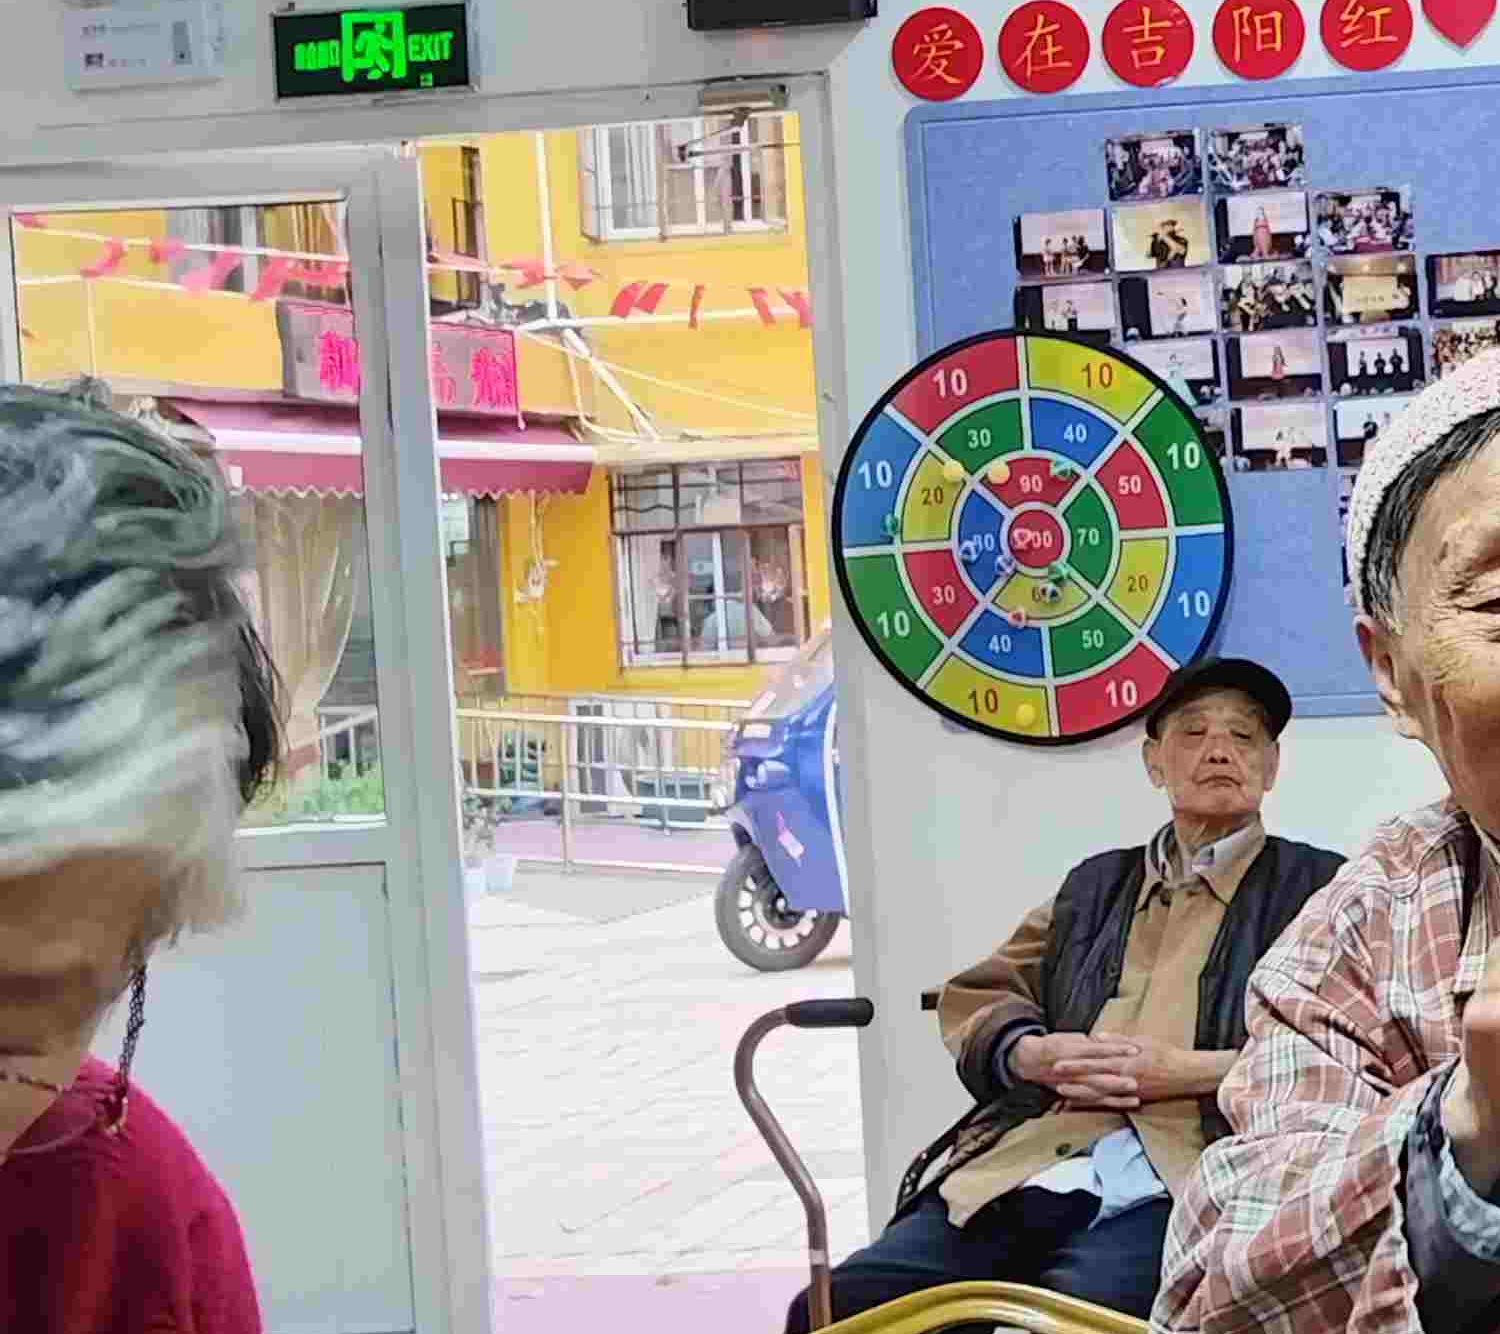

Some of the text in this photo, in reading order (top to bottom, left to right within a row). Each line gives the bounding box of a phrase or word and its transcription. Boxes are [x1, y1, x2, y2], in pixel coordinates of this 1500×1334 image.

[408, 31, 454, 61] EXIT
[933, 369, 967, 397] 10
[1082, 363, 1113, 389] 10
[967, 428, 992, 449] 30
[1063, 423, 1088, 444] 40
[1166, 441, 1201, 470] 10
[857, 460, 893, 490] 10
[1019, 474, 1043, 493] 90
[1117, 474, 1142, 495] 50
[921, 486, 944, 506] 20
[1076, 528, 1100, 547] 70
[1127, 575, 1149, 593] 20
[931, 585, 955, 605] 30
[1178, 589, 1210, 618] 10
[876, 610, 911, 638] 10
[988, 635, 1012, 654] 40
[1081, 629, 1104, 649] 50
[967, 688, 999, 716] 10
[1105, 679, 1138, 708] 10
